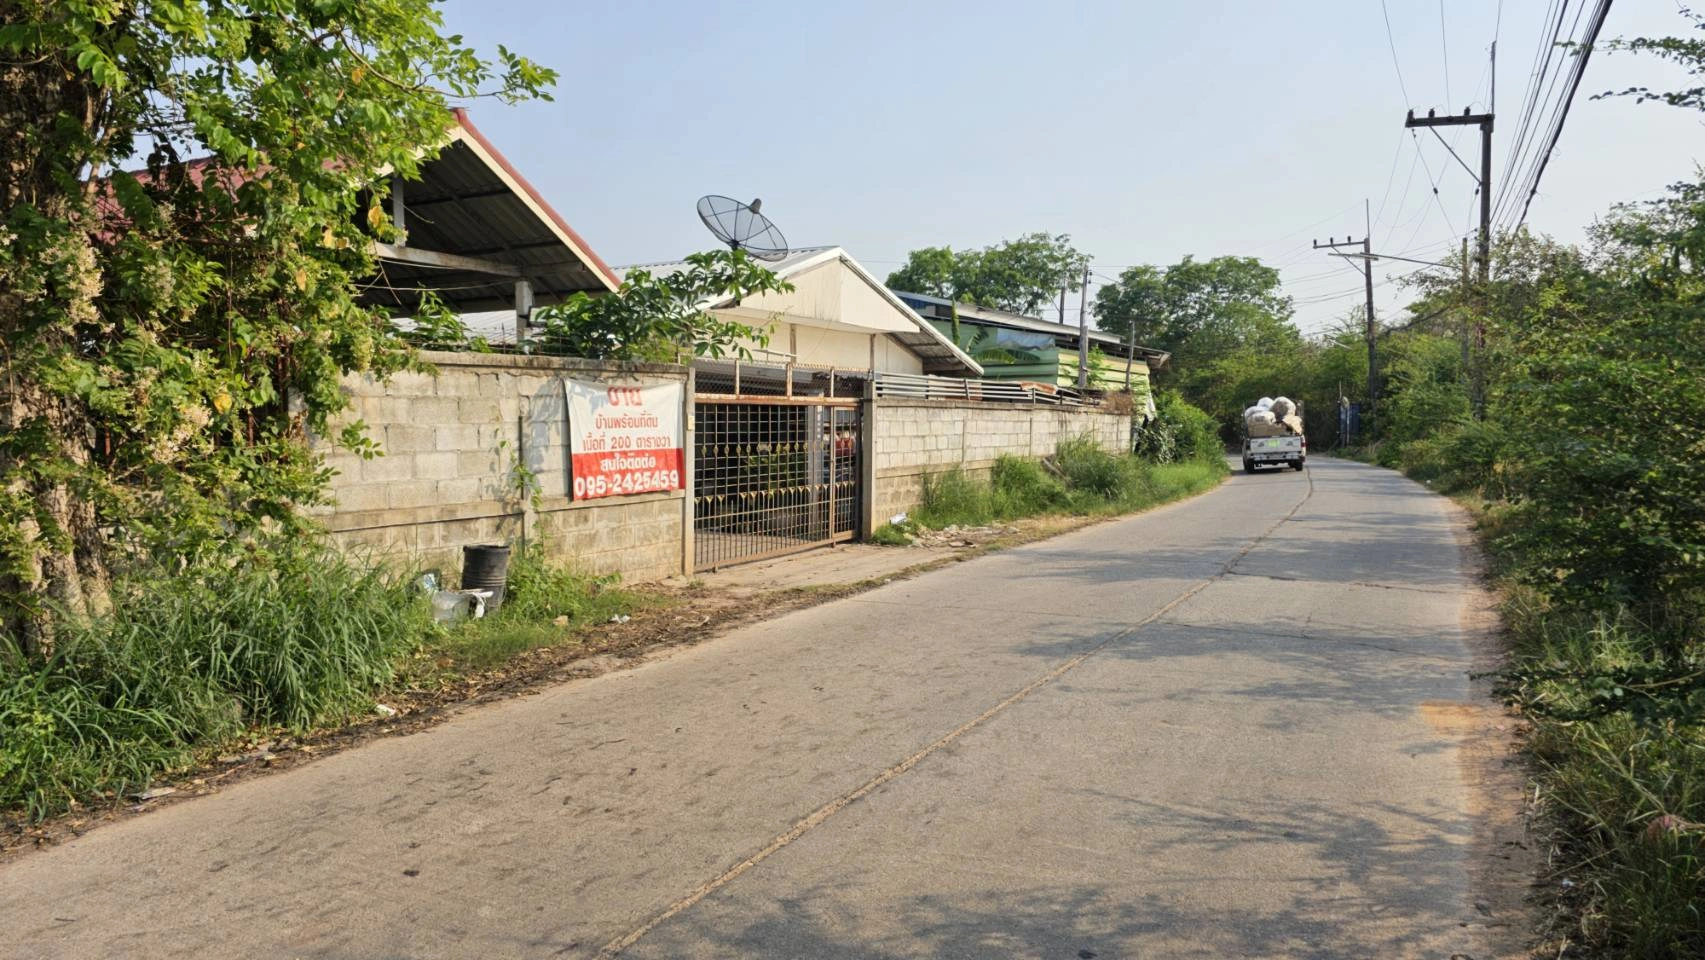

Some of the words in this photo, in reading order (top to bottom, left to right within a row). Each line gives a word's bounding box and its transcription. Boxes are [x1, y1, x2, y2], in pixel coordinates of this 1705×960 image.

[595, 410, 659, 430] บ้านพร้อมที่ดิน
[611, 436, 631, 449] 200
[636, 435, 671, 449] ตารางวา
[600, 452, 657, 471] สนใจติดต่อ
[575, 469, 680, 497] 095-2425459
